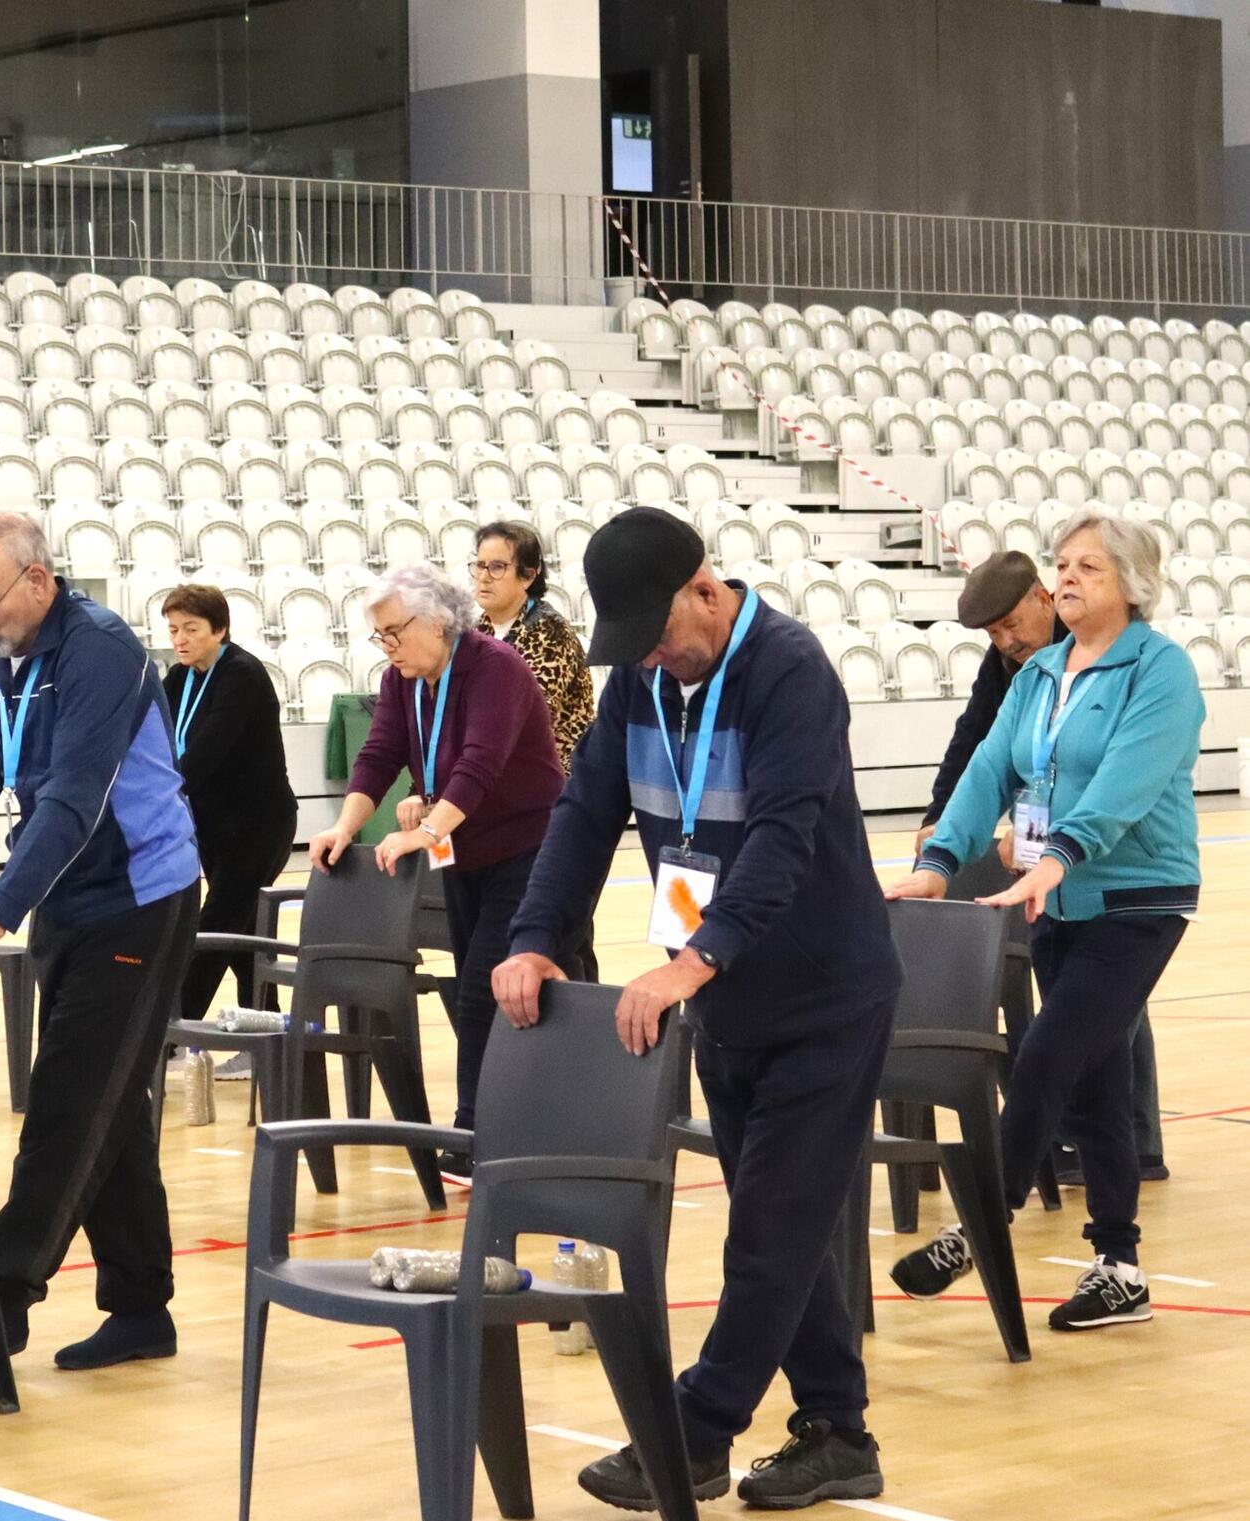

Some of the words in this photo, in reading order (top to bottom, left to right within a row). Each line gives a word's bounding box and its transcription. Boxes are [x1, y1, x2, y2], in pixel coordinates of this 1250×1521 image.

[657, 426, 666, 437] B
[735, 479, 743, 491] C
[813, 534, 822, 546] D
